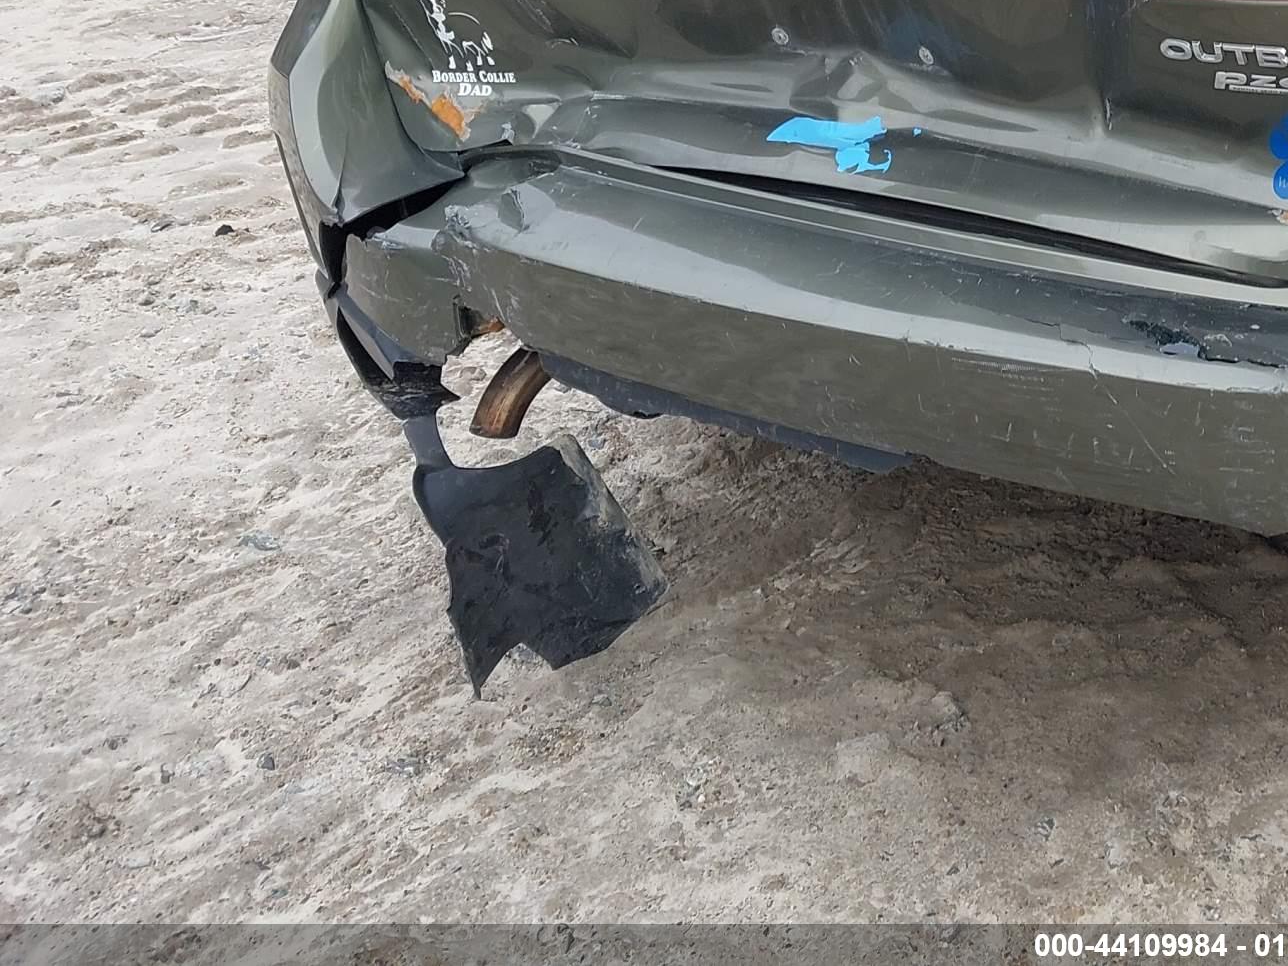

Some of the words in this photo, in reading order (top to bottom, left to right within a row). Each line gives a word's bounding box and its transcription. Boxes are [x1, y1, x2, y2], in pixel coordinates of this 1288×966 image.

[432, 70, 477, 83] BORDER
[479, 70, 517, 83] COLLIE
[457, 83, 492, 97] DAD
